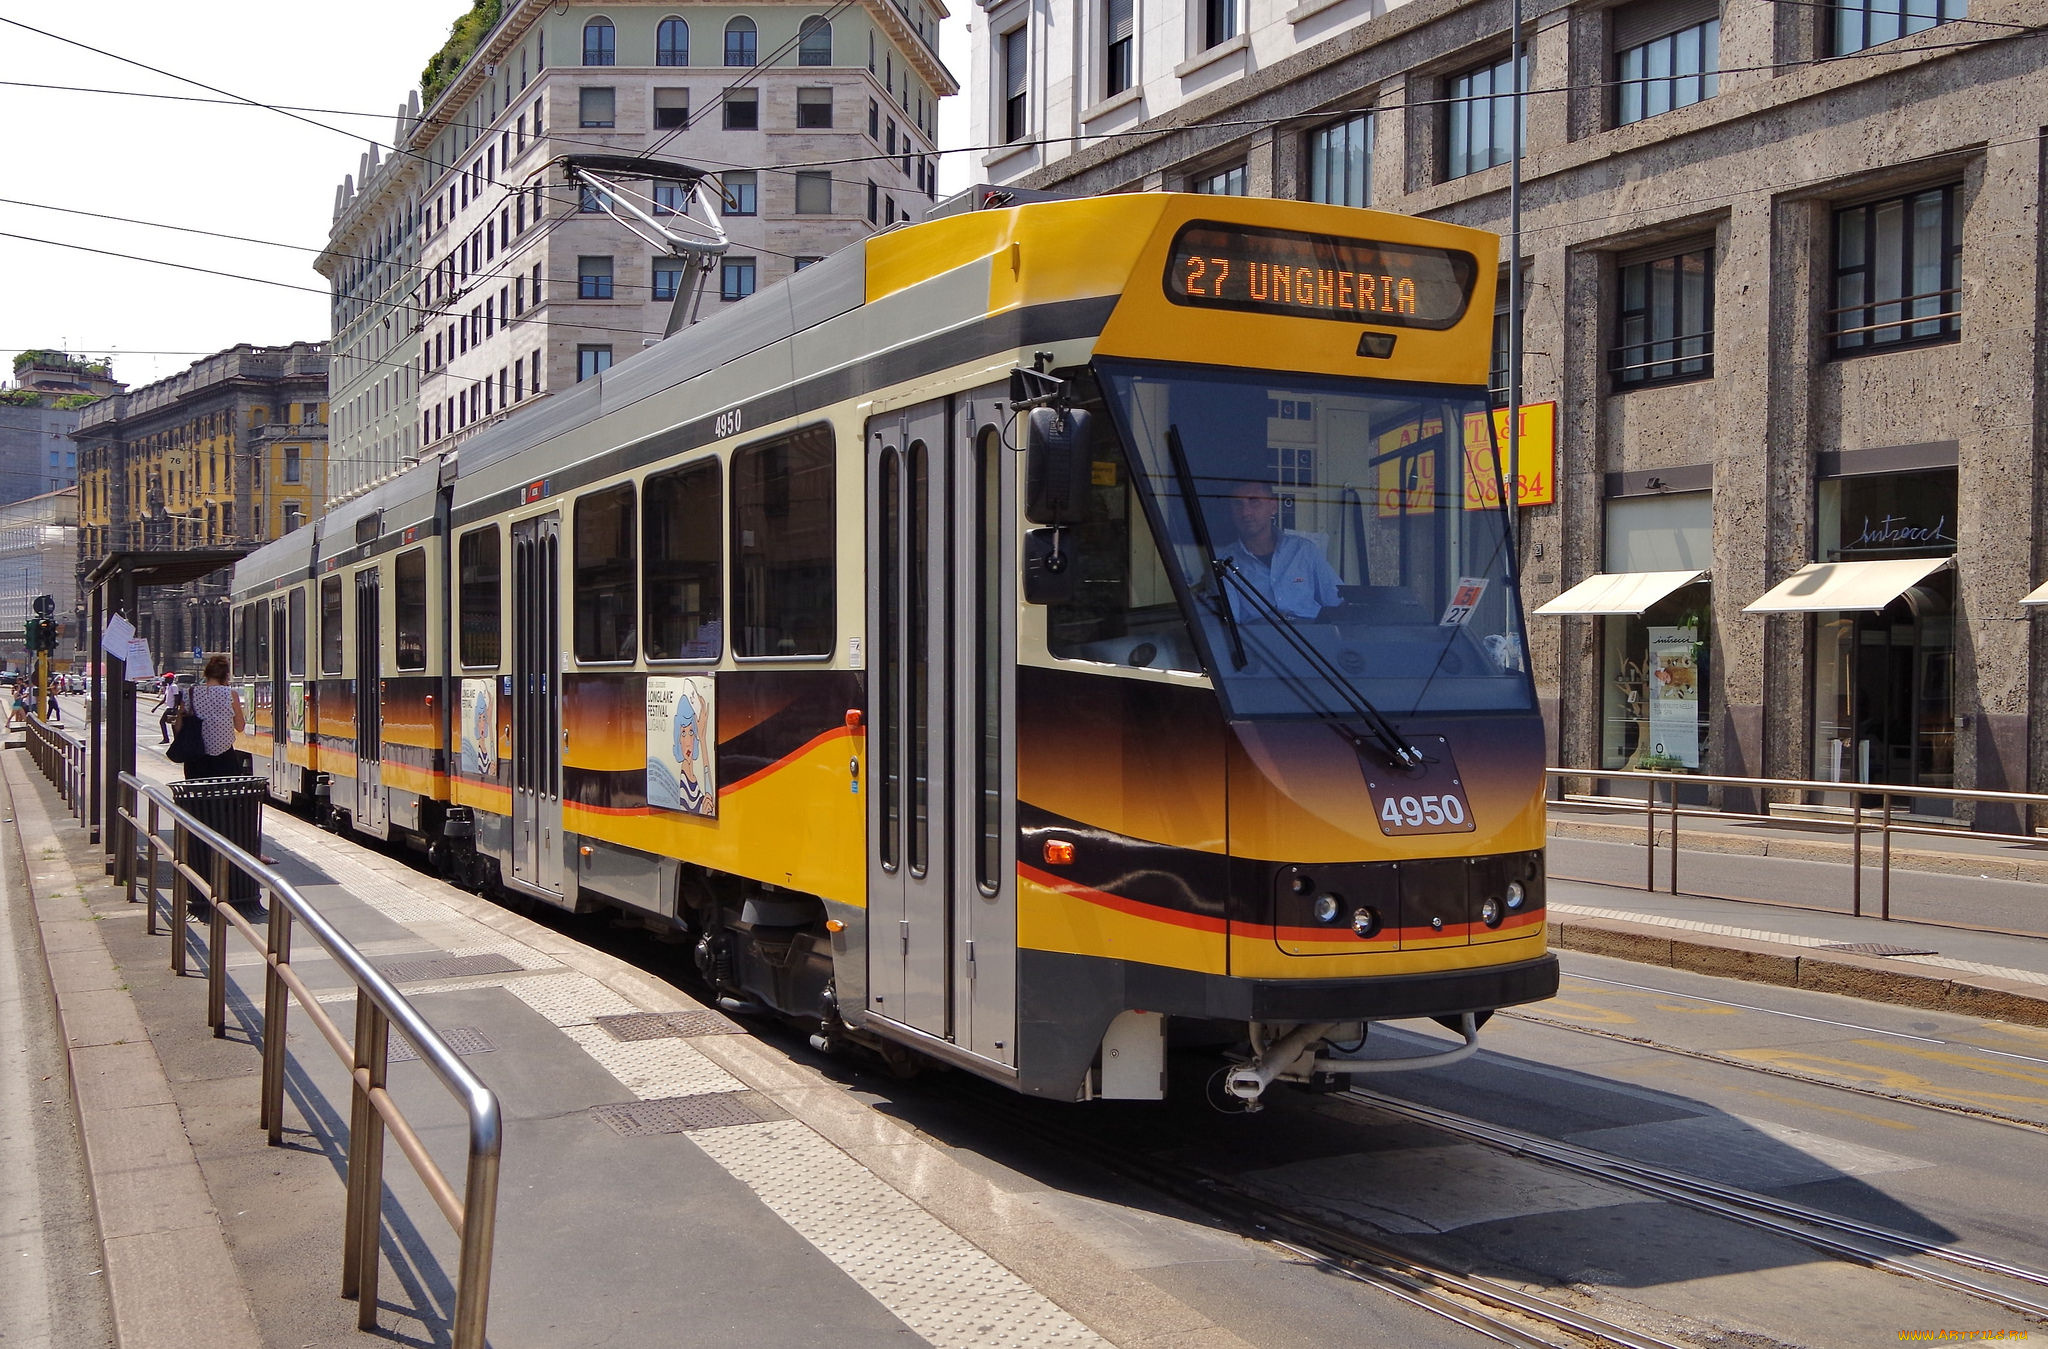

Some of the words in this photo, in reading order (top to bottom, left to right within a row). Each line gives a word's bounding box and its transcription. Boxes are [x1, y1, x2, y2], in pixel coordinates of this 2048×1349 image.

[1187, 256, 1230, 296] 27
[1250, 261, 1416, 314] UNGHERIA
[715, 409, 741, 437] 4950
[1446, 607, 1471, 624] 27
[648, 690, 673, 704] LONGLAKE
[648, 704, 668, 718] FESTIVAL
[1381, 794, 1464, 826] 4950
